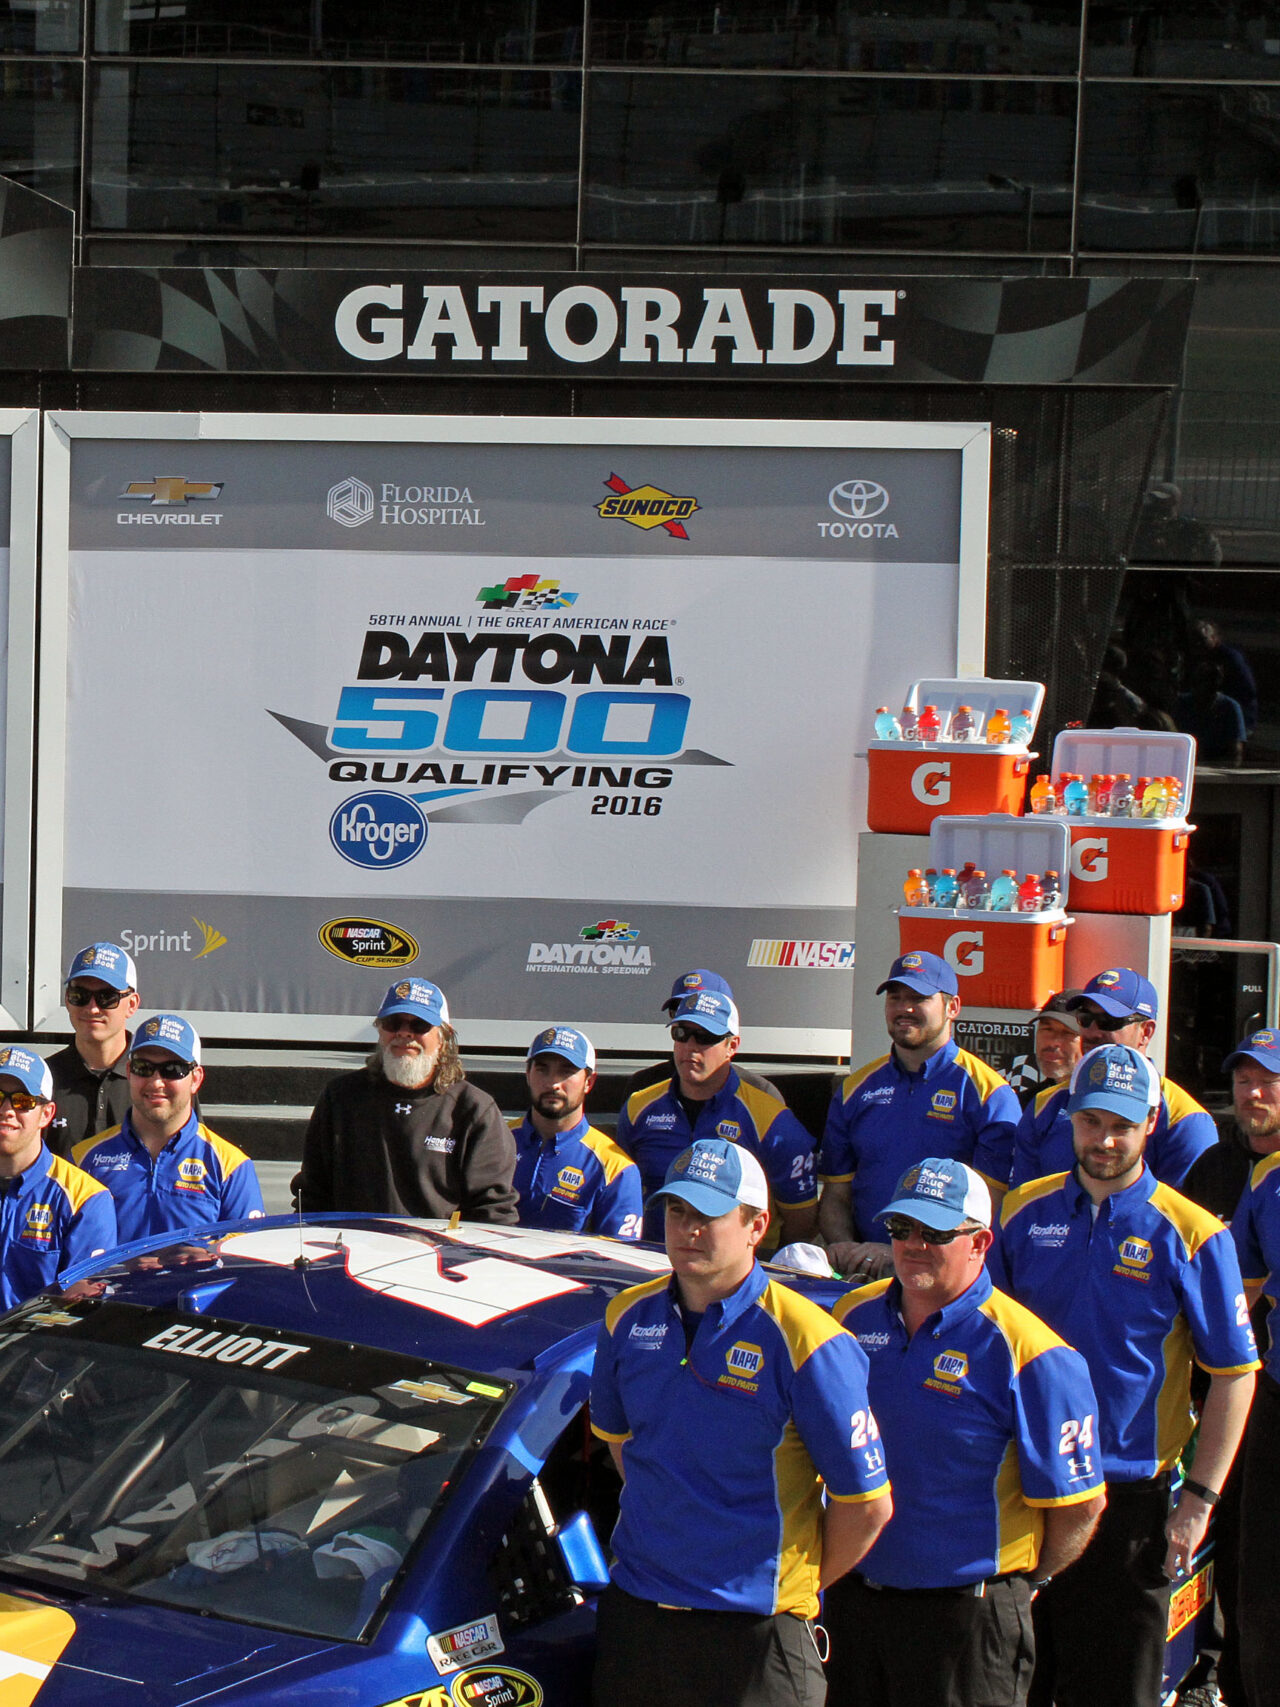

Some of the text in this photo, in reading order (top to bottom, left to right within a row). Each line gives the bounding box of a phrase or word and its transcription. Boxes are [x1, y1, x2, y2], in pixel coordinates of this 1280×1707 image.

[334, 284, 897, 365] GATORADE
[380, 483, 474, 503] FLORIDA
[380, 505, 486, 525] HOSPITAL
[602, 499, 693, 517] SUNOCO
[117, 513, 223, 525] CHEVROLET
[817, 521, 900, 539] TOYOTA
[369, 614, 669, 631] 58TH ANNUAL THE GREAT AMERICAN RACE
[357, 631, 673, 686] DAYTONA
[331, 686, 692, 755] 500
[328, 761, 674, 788] QUALIFYING
[911, 762, 951, 806] G
[591, 795, 662, 816] 2016
[341, 803, 420, 860] Kroger
[1070, 837, 1108, 882] G
[347, 927, 381, 938] NASCAR
[120, 929, 191, 957] Sprint
[352, 939, 385, 953] Sprint
[375, 956, 408, 964] SERIES
[527, 943, 653, 967] DAYTONA
[790, 941, 855, 968] NASC
[943, 931, 984, 976] G
[525, 964, 651, 975] INTERNATIONAL SPEEDWAY
[695, 1005, 716, 1016] Book
[956, 1022, 1030, 1036] GATORADE
[1108, 1071, 1132, 1081] Blue
[932, 1094, 956, 1108] NAPA
[646, 1113, 677, 1126] Hendrick
[718, 1124, 741, 1139] NAPA
[690, 1157, 717, 1172] Blue
[694, 1149, 726, 1166] Kelley
[791, 1153, 815, 1179] 24
[182, 1163, 202, 1175] NAPA
[560, 1169, 583, 1187] NAPA
[687, 1166, 717, 1182] Book
[916, 1183, 944, 1199] Book
[919, 1176, 944, 1190] Blue
[619, 1213, 643, 1239] 24
[1123, 1242, 1148, 1261] NAPA
[142, 1324, 311, 1370] ELLIOTT
[857, 1332, 890, 1345] ndrick
[730, 1350, 759, 1371] NAPA
[938, 1354, 964, 1376] NAPA
[718, 1374, 759, 1392] AUTO PARTS
[924, 1377, 940, 1388] AUTO
[851, 1406, 879, 1449] 24
[1059, 1415, 1094, 1455] 24
[454, 1622, 489, 1650] NASCAR
[439, 1642, 497, 1667] RACE CAR
[476, 1675, 504, 1696] NASCAR
[485, 1689, 515, 1707] Sprint
